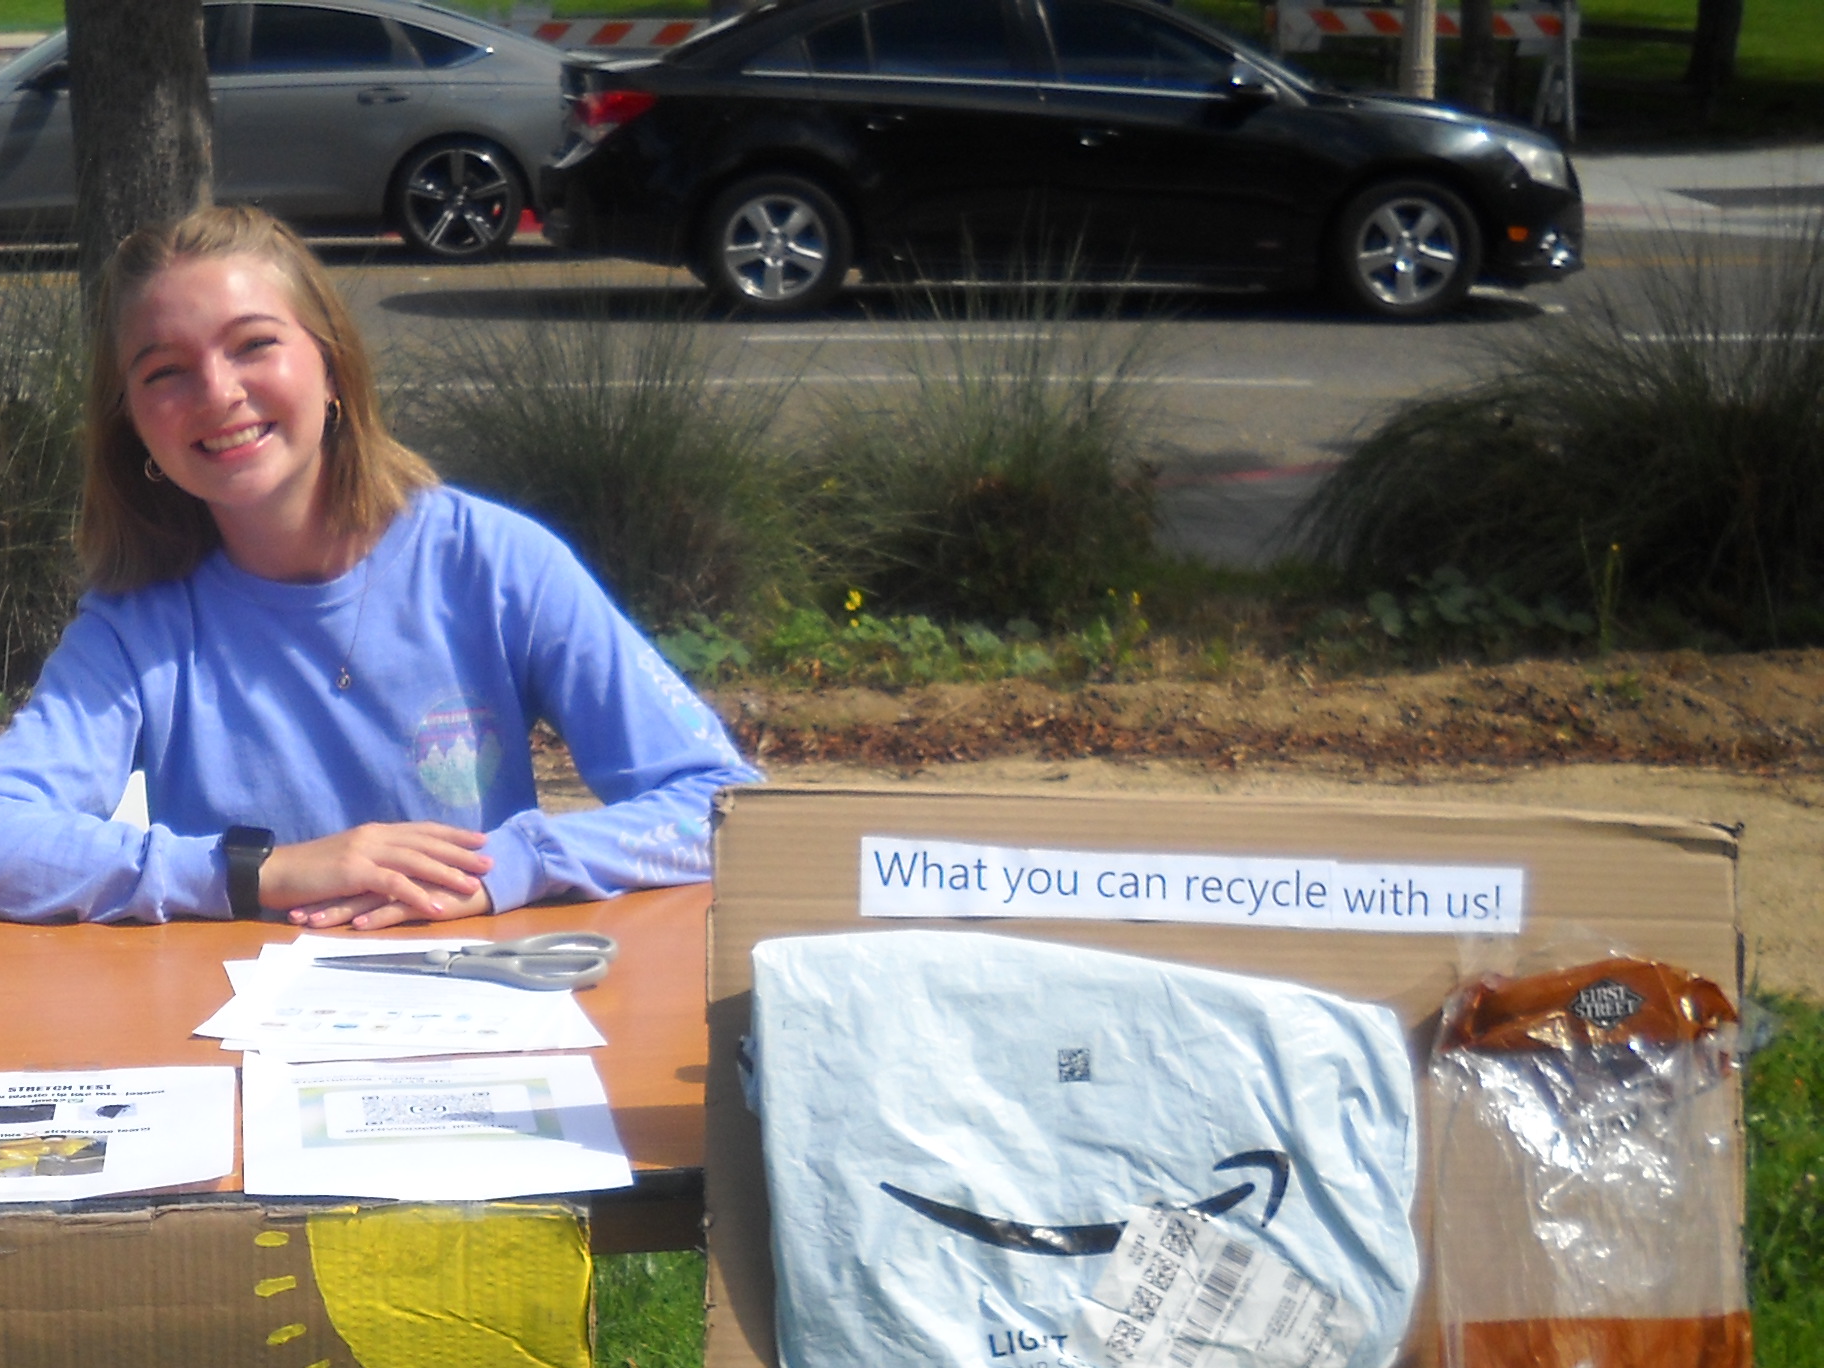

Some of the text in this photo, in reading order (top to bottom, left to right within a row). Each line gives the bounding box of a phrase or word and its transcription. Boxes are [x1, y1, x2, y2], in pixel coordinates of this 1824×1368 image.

[874, 850, 1501, 920] What you can recycle with us!
[1579, 985, 1626, 1004] FIRST
[1575, 1000, 1634, 1018] STREET
[7, 1085, 73, 1093] STRETCH
